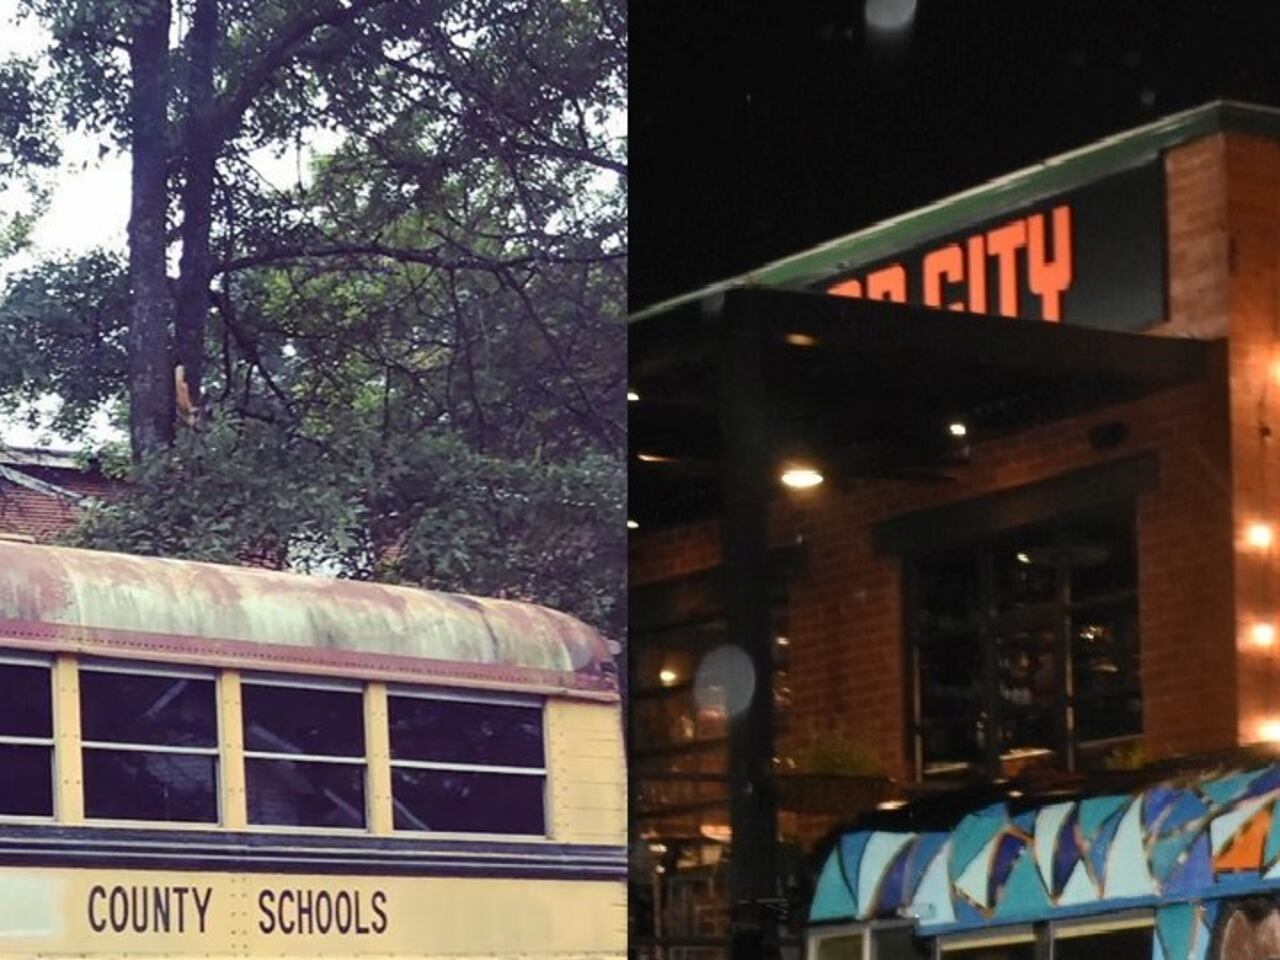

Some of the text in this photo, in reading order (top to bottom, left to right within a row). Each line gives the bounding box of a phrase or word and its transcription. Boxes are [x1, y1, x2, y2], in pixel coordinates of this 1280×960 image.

[923, 204, 1073, 323] CITY
[88, 885, 388, 935] COUNTY SCHOOLS
